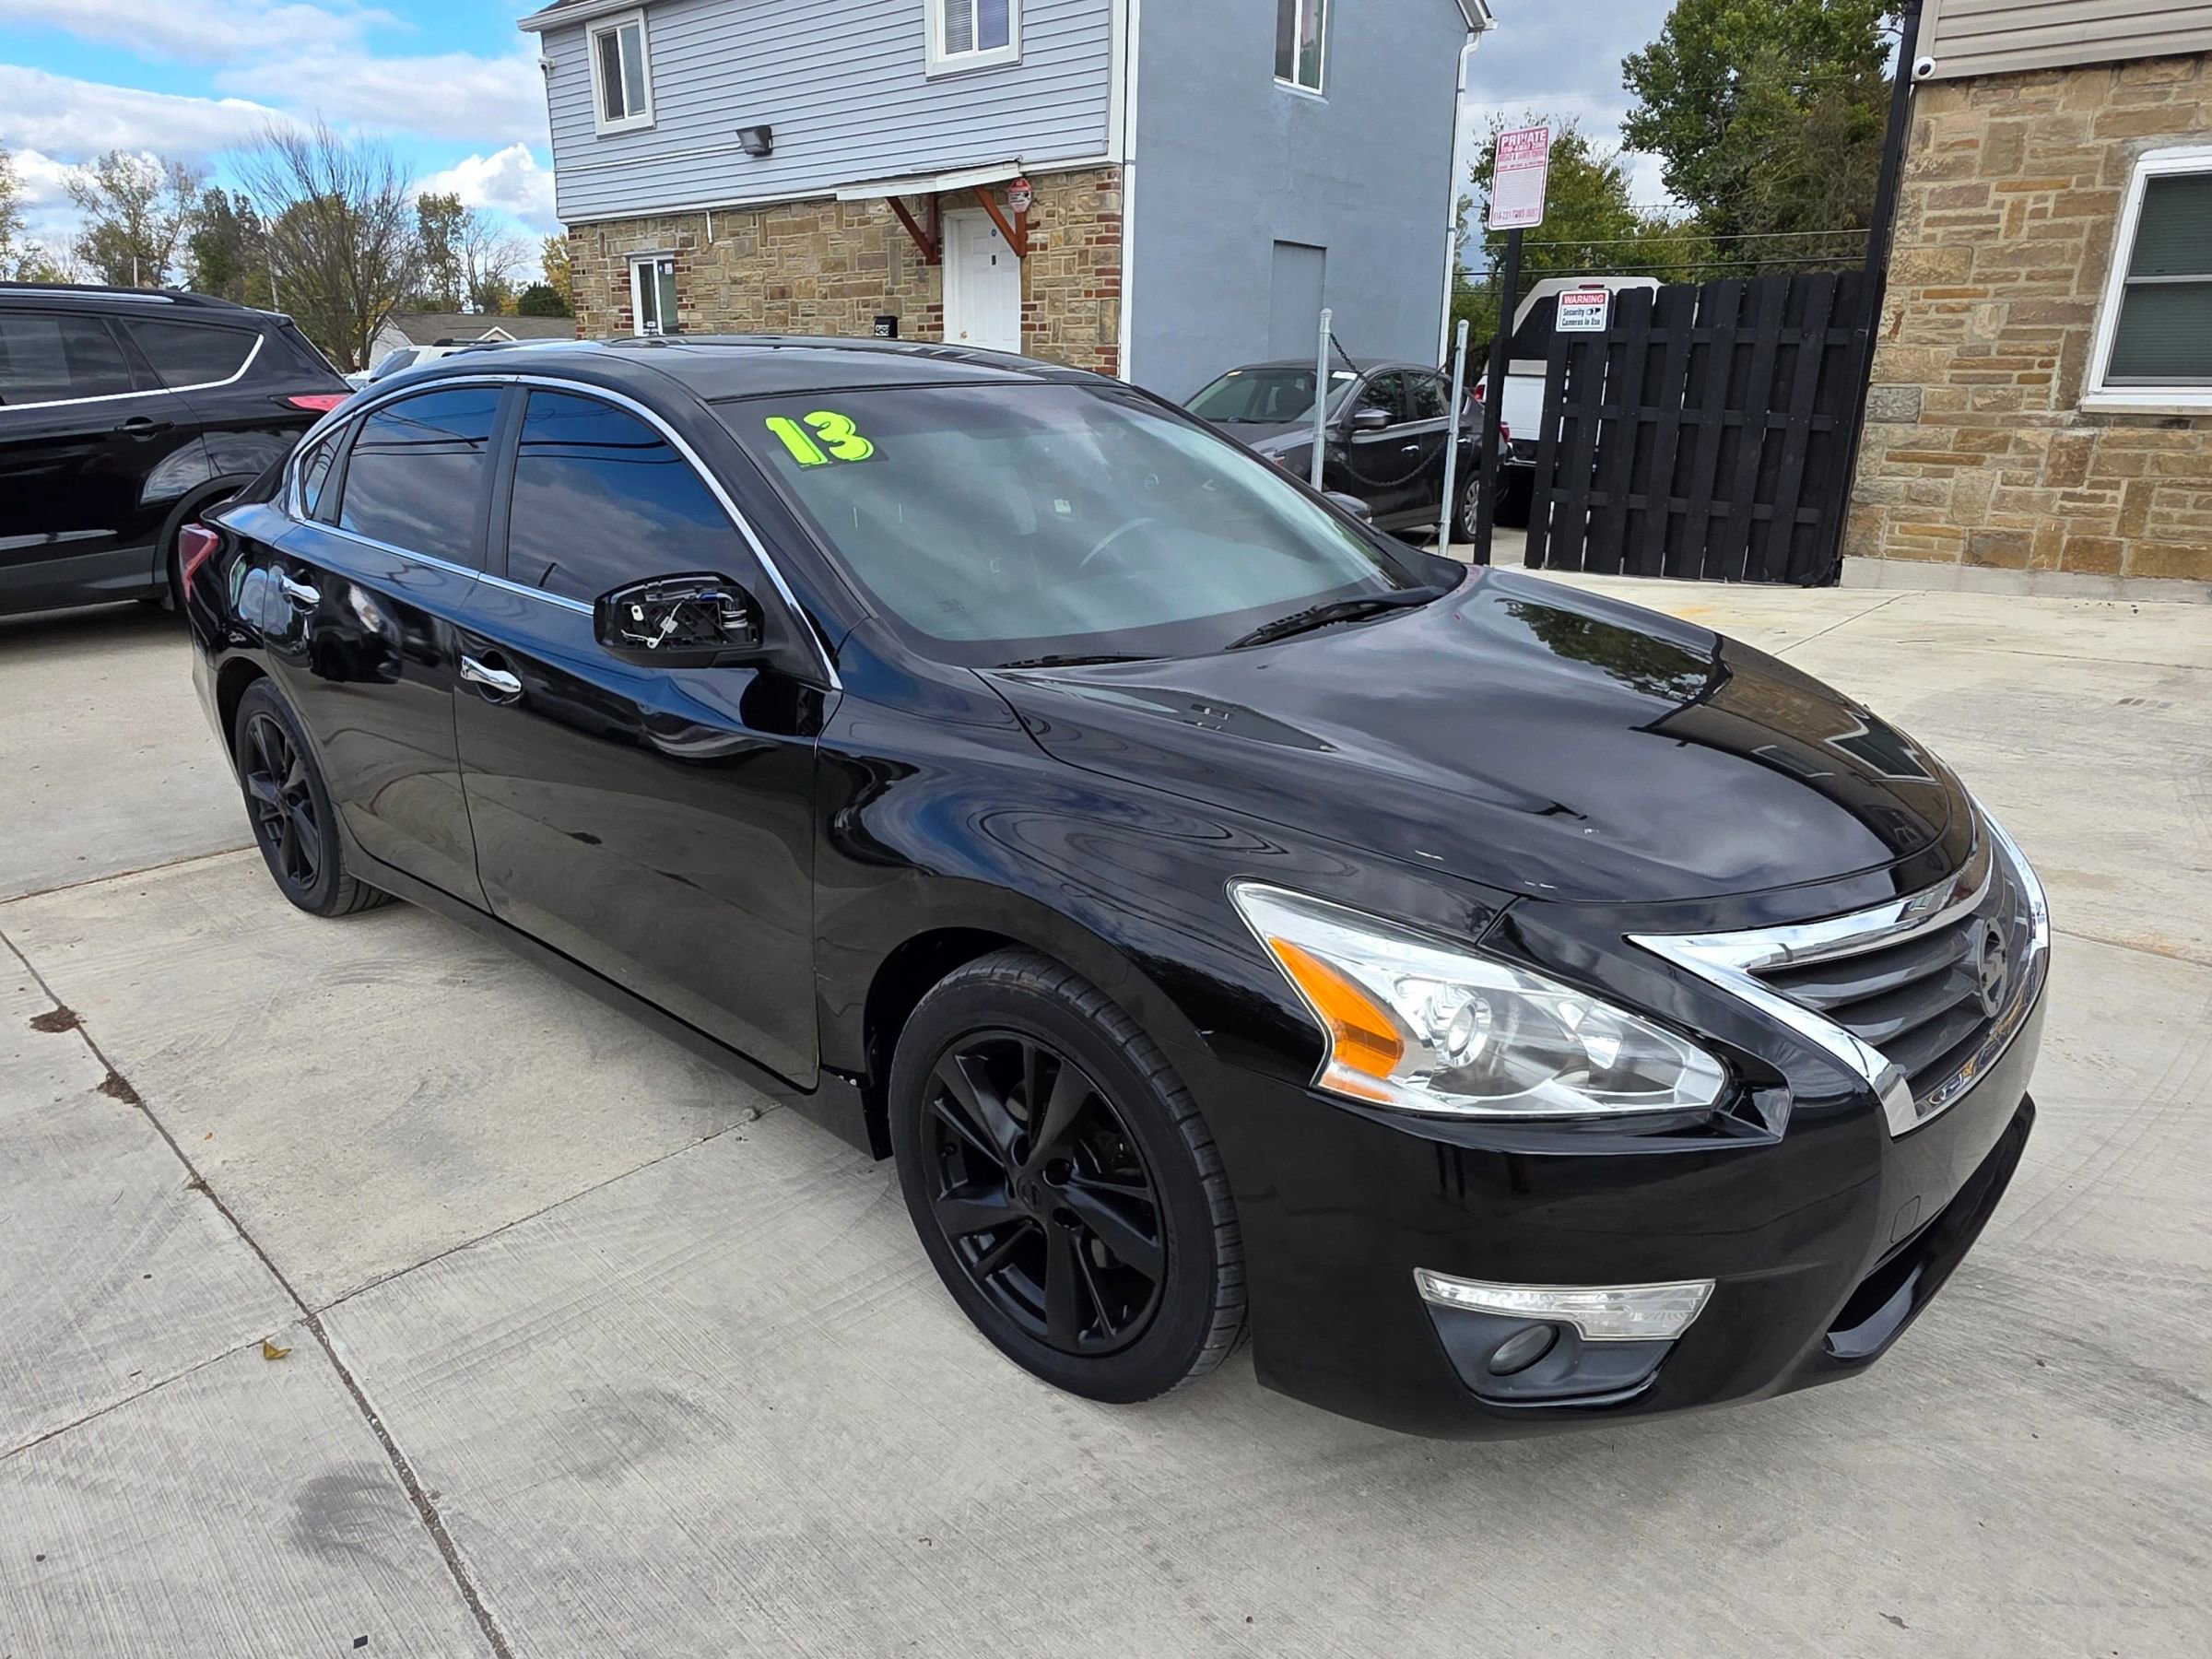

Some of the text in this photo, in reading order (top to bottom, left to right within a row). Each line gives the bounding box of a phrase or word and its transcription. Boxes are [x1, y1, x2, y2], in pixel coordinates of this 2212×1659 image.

[1500, 129, 1547, 147] PRIVATE
[1564, 294, 1604, 304] WARNING
[1563, 308, 1584, 317] Security
[1562, 318, 1583, 326] Cameras
[765, 410, 875, 465] 13
